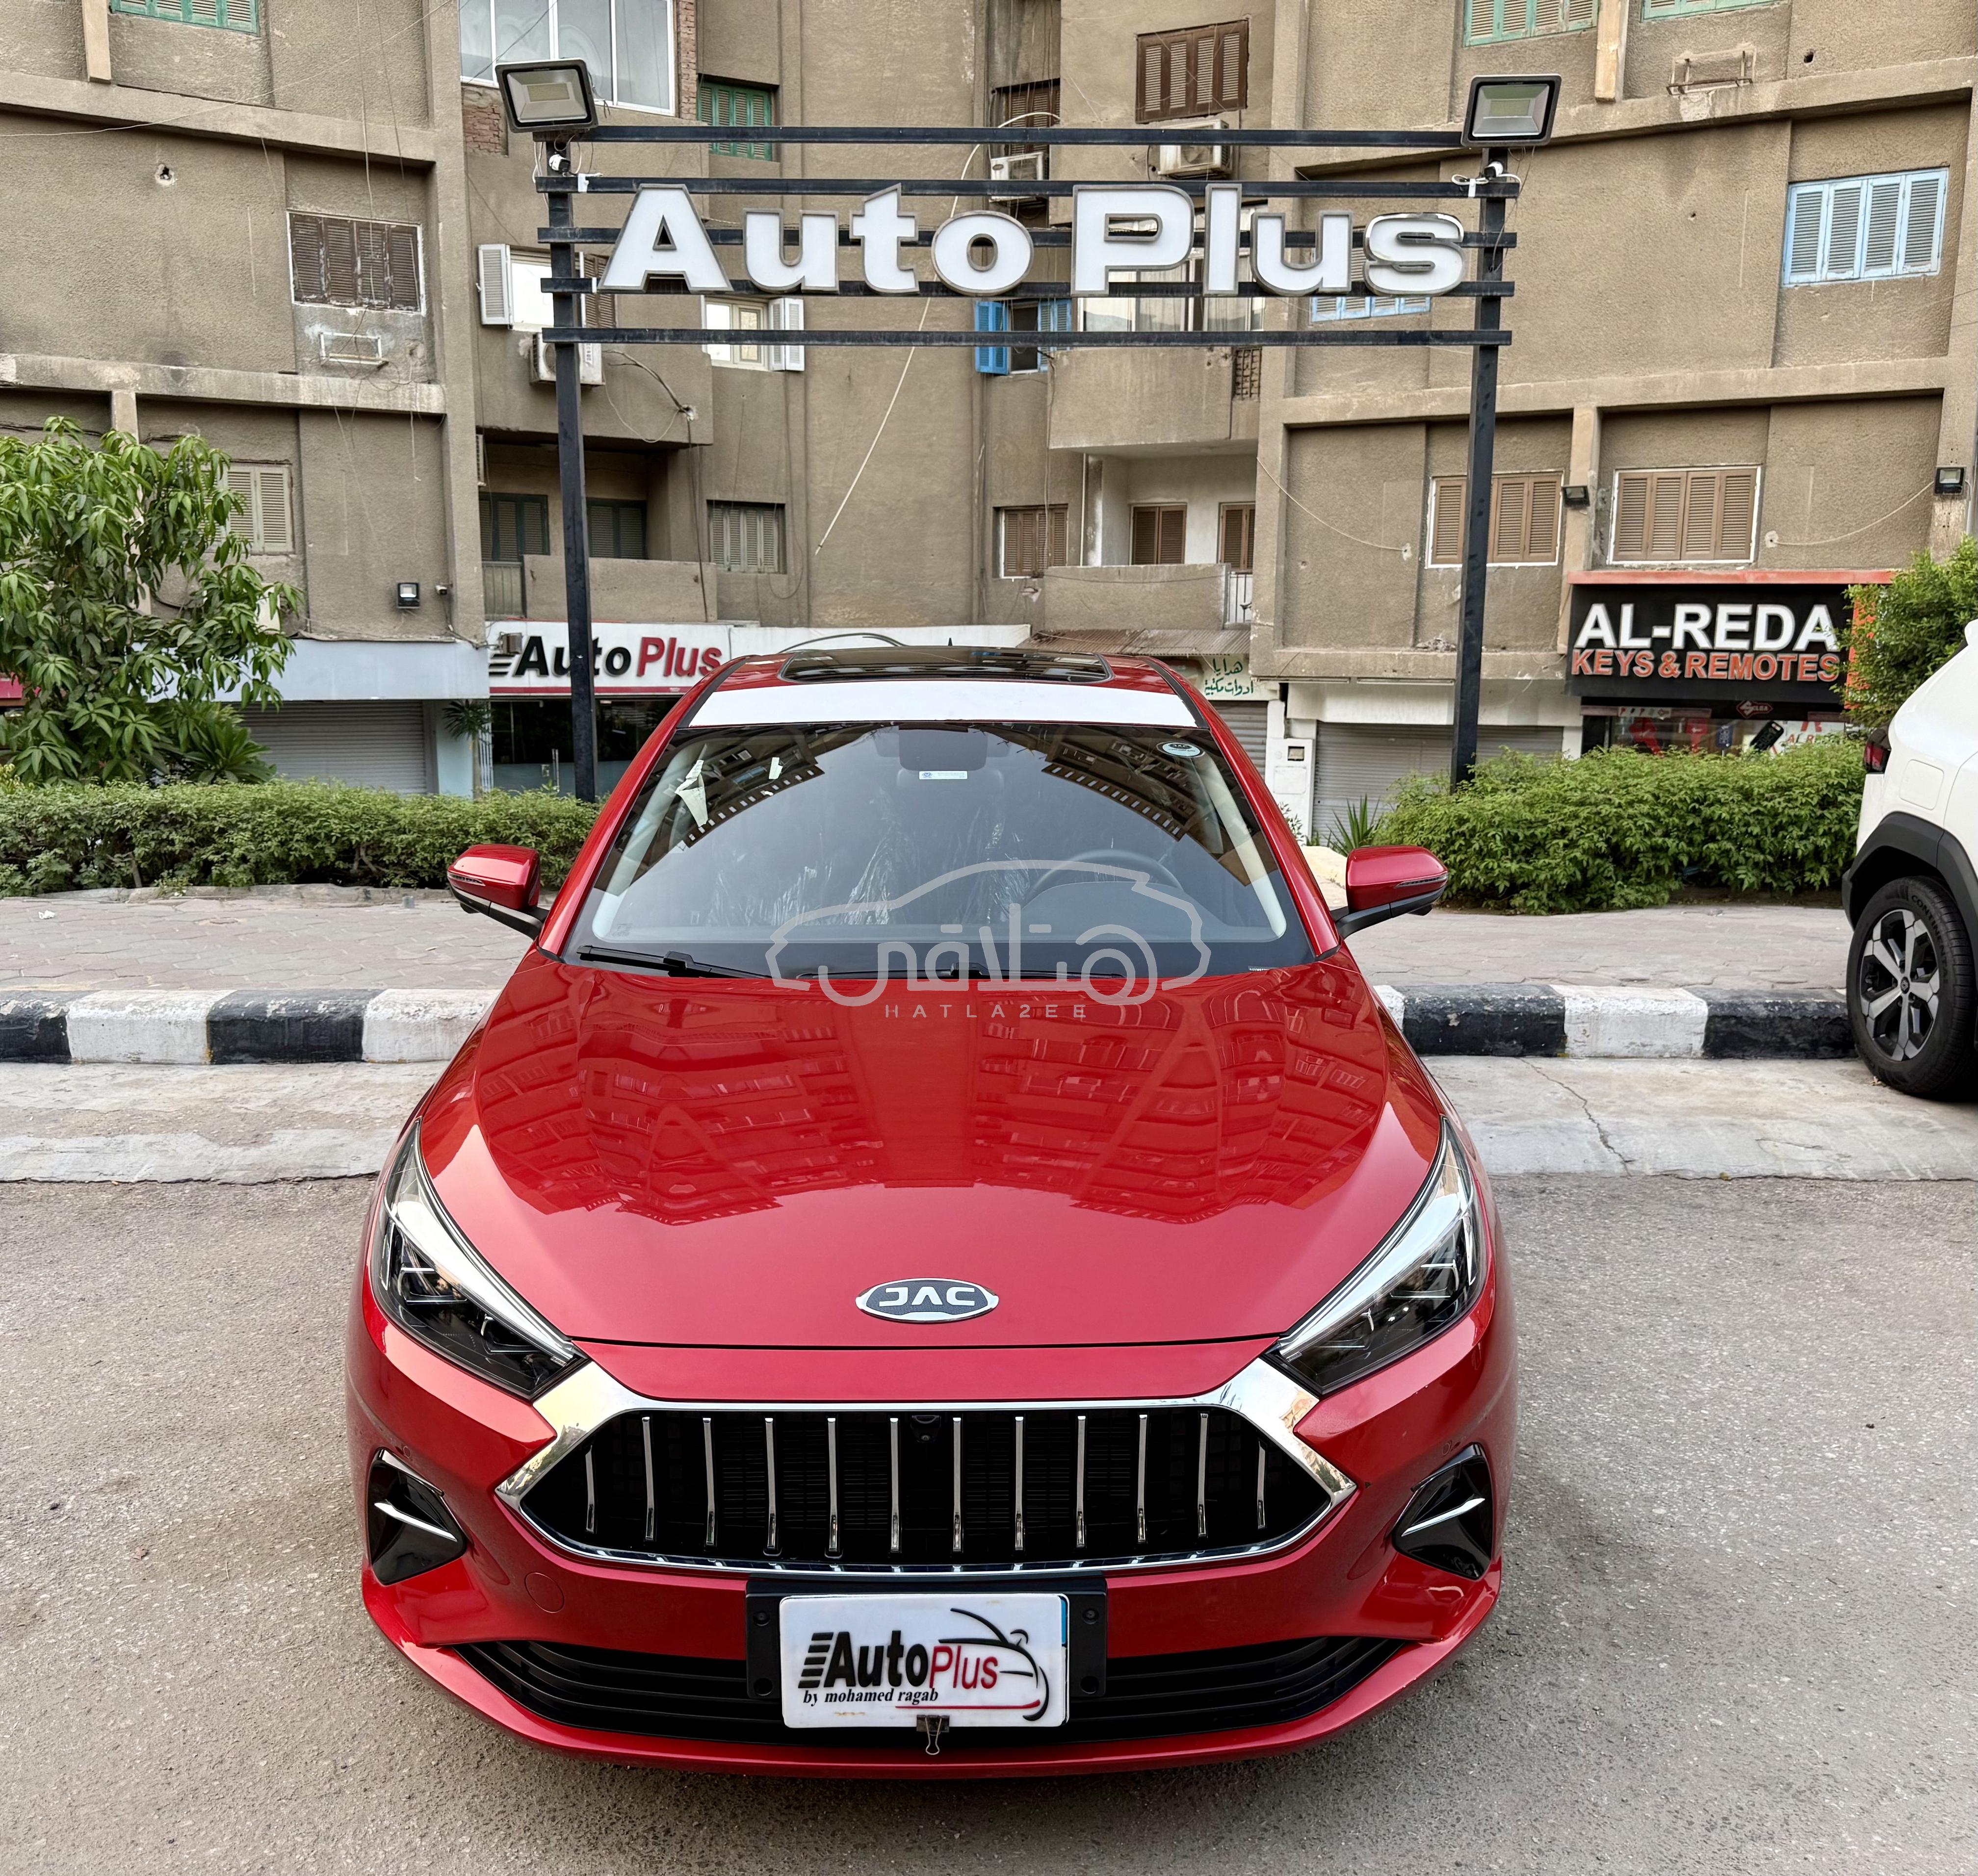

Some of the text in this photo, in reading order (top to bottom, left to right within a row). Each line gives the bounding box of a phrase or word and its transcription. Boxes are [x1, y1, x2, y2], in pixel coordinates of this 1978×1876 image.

[598, 183, 1465, 297] Auto Plus
[1574, 603, 1841, 652] AL-REDA
[1213, 658, 1243, 676] هدايا
[1571, 648, 1840, 682] KEYS & REMOTES
[879, 1286, 975, 1307] JAC
[803, 1688, 939, 1707] by mohamed ragab
